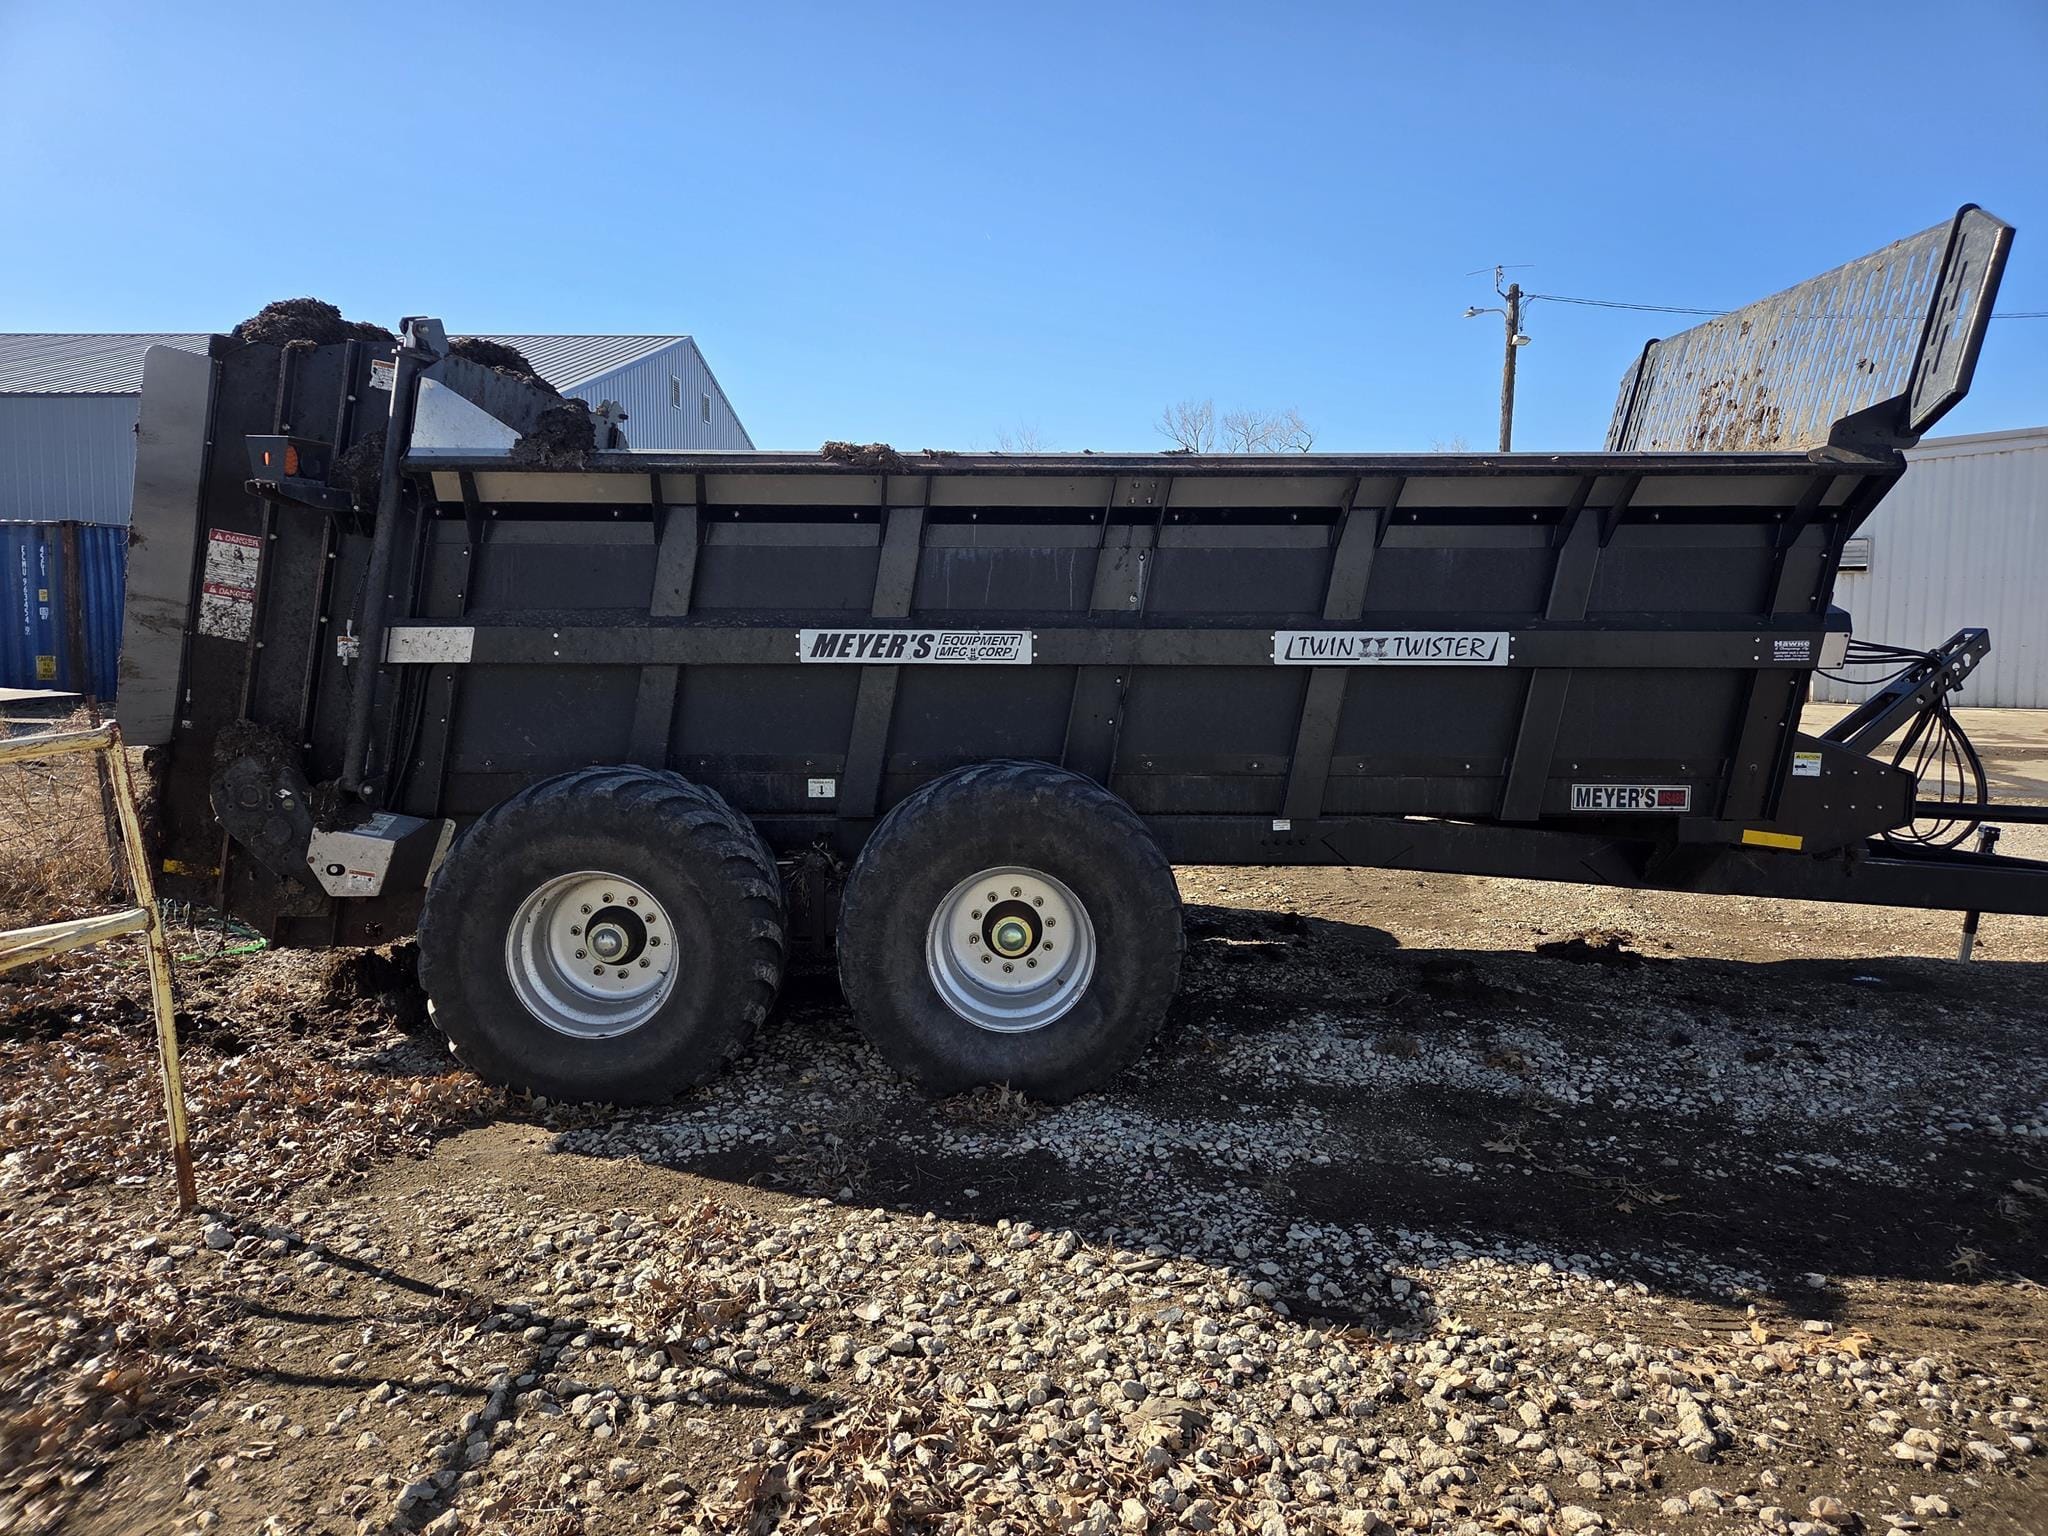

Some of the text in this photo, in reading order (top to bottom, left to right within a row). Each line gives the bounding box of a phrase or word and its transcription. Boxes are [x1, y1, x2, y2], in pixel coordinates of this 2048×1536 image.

[225, 534, 259, 547] DANGER
[218, 587, 252, 599] DANGER
[809, 633, 935, 659] MEYER'S
[943, 635, 1019, 646] EQUIPMENT
[1298, 636, 1486, 658] TWIN TWISTER
[939, 646, 1014, 658] MFG. CORP.
[1575, 787, 1656, 808] MEYER'S
